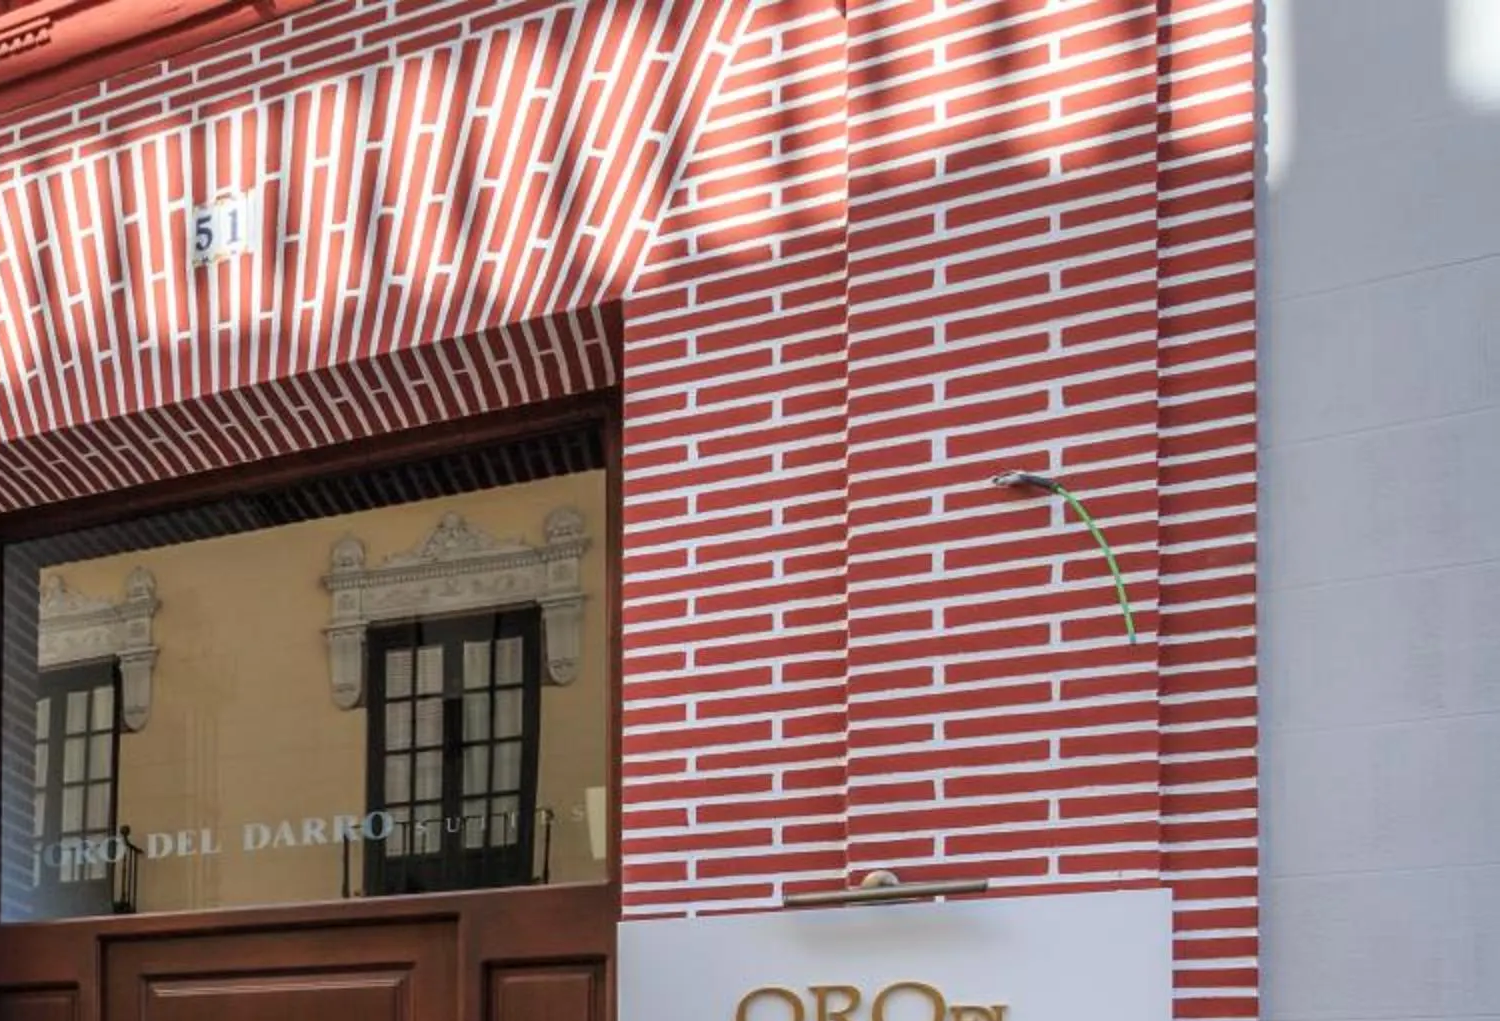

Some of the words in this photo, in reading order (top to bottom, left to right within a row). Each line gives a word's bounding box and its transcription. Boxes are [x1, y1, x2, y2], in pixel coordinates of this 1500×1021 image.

[195, 208, 240, 252] 51
[43, 836, 126, 867] ORO
[146, 829, 222, 859] DEL
[242, 811, 394, 851] DARRO
